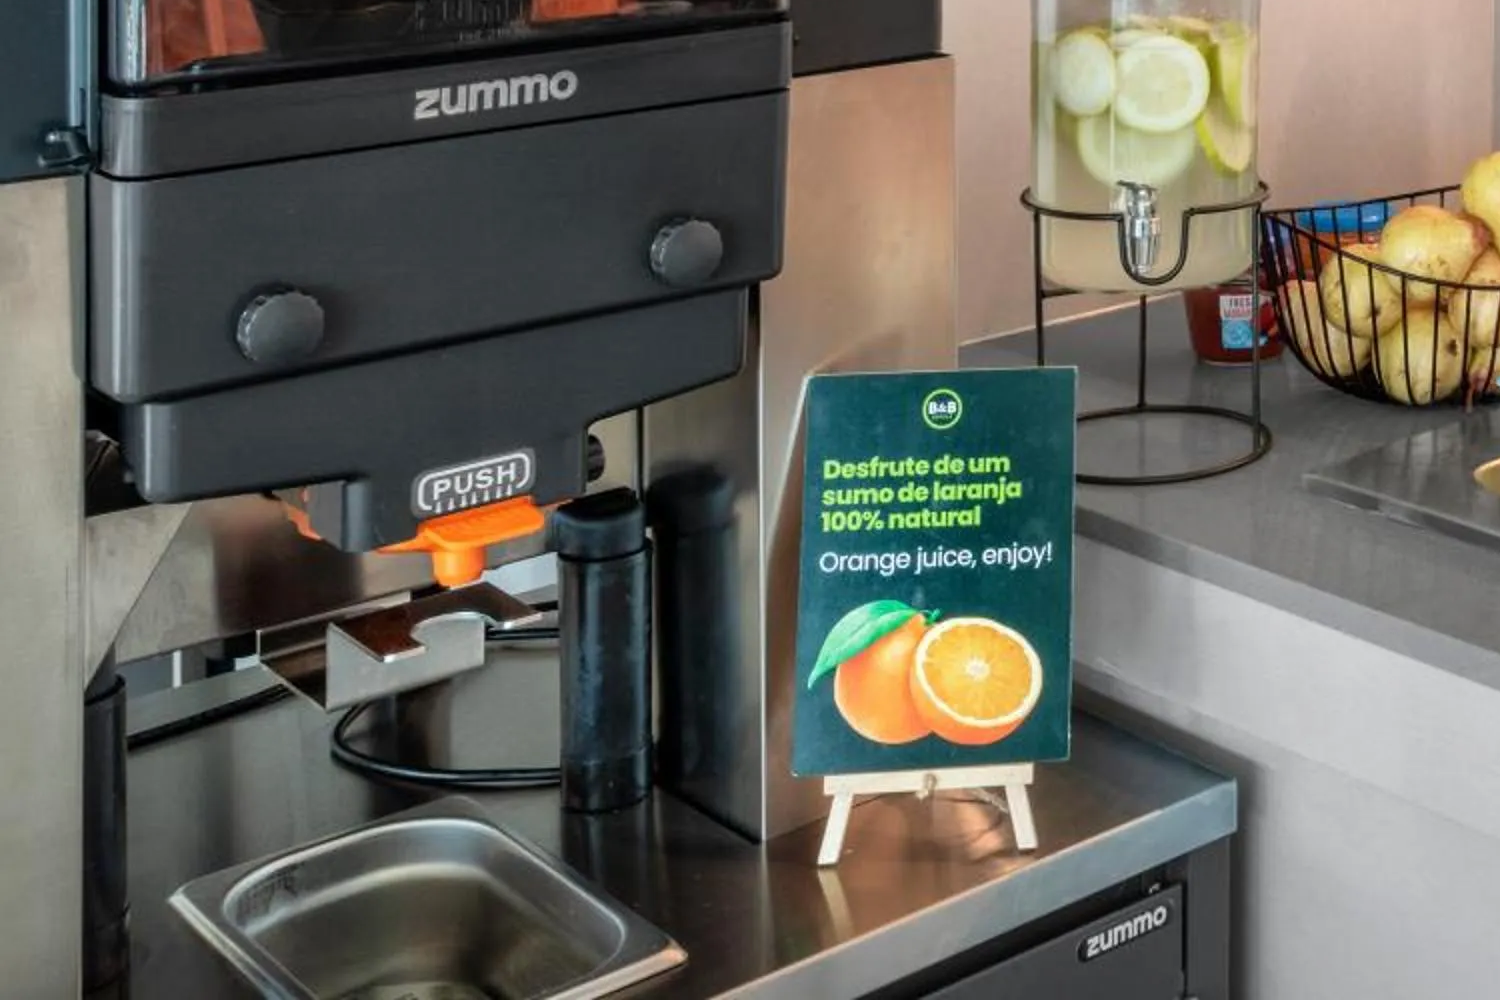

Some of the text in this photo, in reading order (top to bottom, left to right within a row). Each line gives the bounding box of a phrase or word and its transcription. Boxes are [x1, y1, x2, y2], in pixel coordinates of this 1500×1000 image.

[414, 69, 578, 121] zummo
[928, 400, 957, 415] B&B
[433, 462, 517, 501] PUSH
[823, 454, 1011, 480] Desfrute de um
[822, 477, 1023, 505] sumo de laranja
[822, 505, 982, 533] 100% natural
[819, 541, 1054, 577] Orange juice, enjoy!
[1087, 905, 1168, 958] zummo
